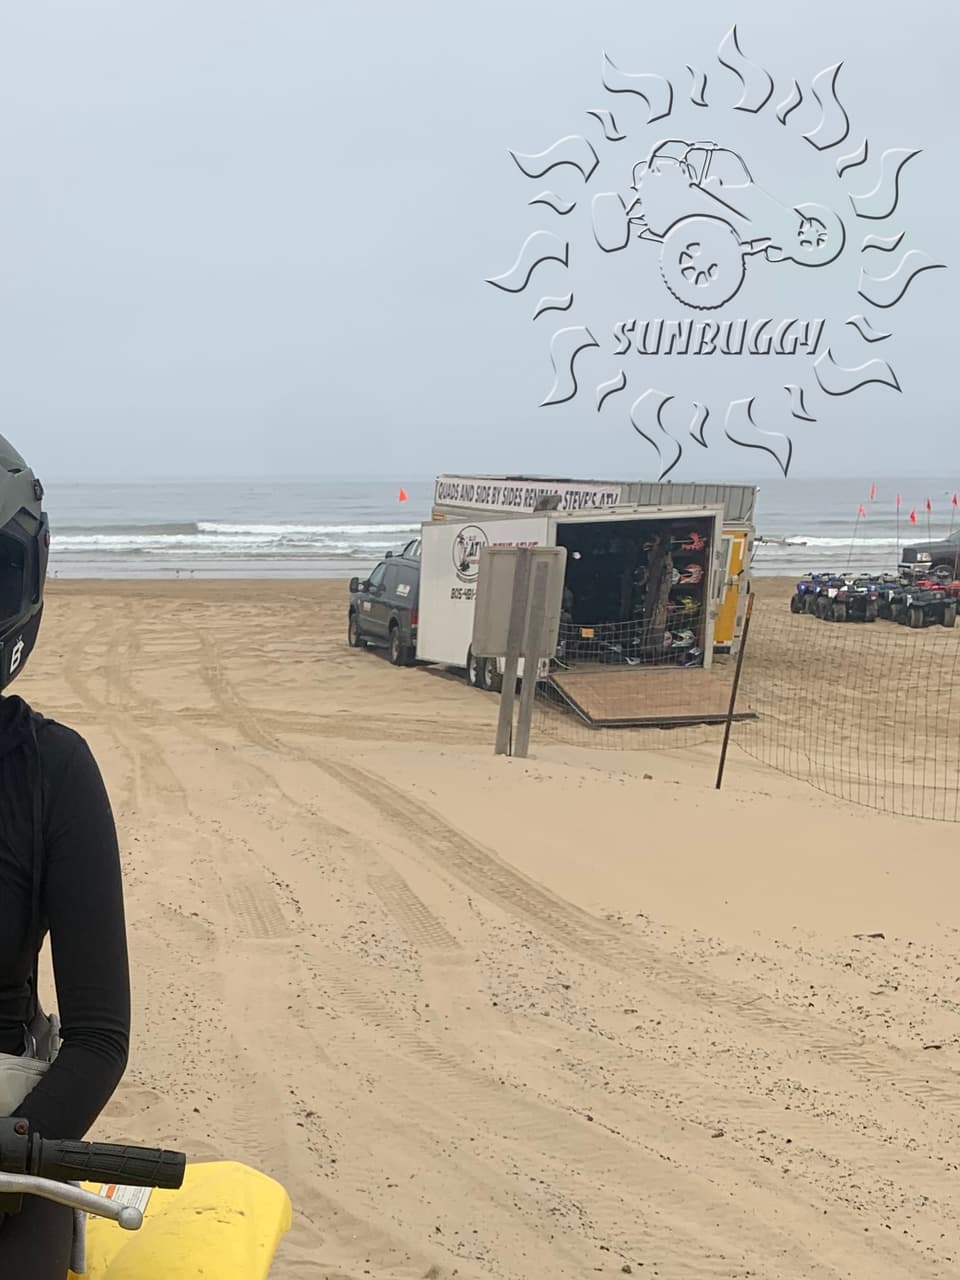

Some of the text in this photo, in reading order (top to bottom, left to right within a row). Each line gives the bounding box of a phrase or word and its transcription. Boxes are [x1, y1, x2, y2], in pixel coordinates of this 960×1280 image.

[460, 484, 474, 502] AND
[475, 485, 492, 504] SIDE
[502, 487, 523, 507] SIDES
